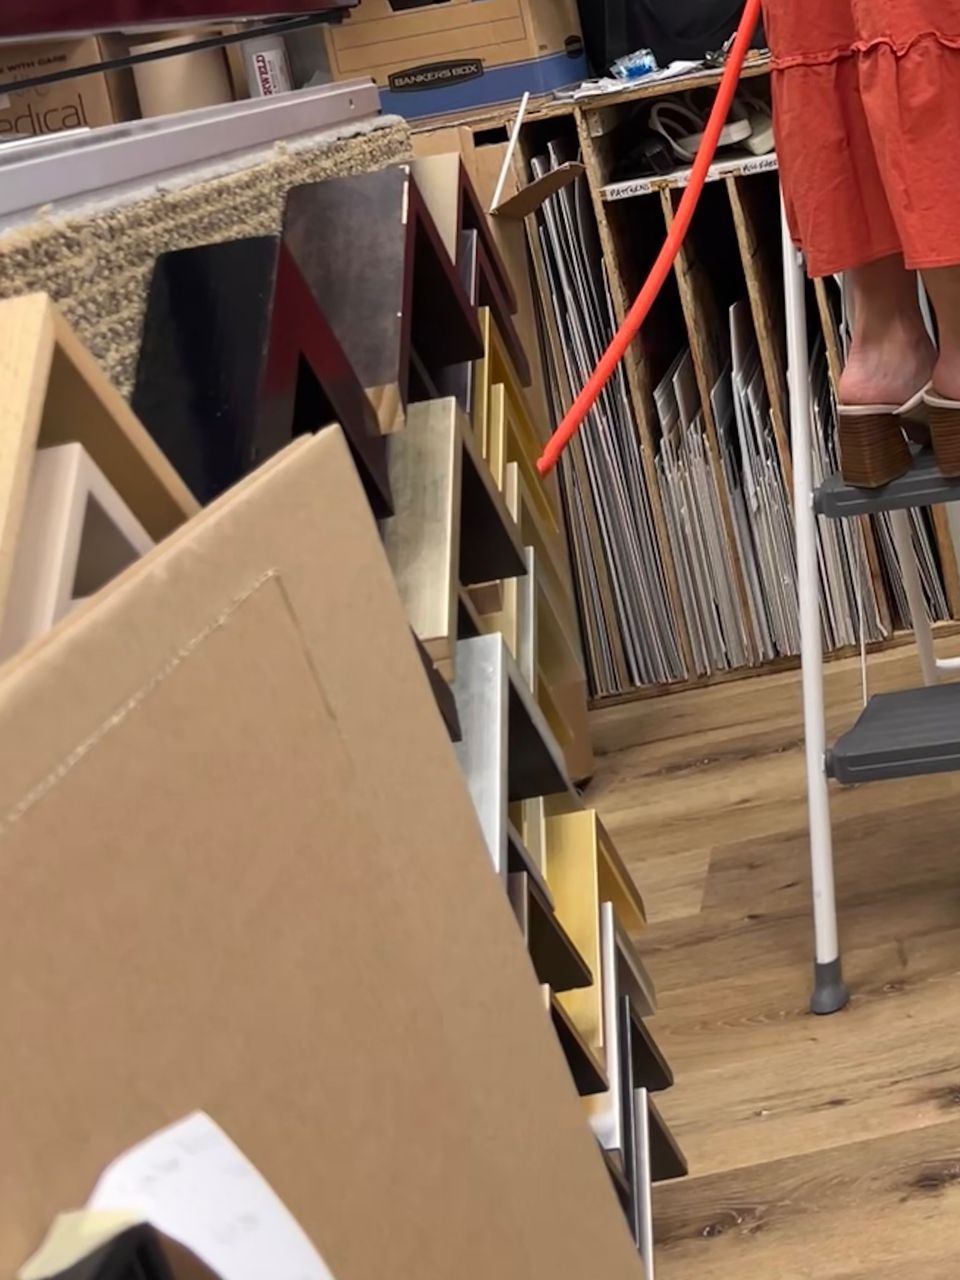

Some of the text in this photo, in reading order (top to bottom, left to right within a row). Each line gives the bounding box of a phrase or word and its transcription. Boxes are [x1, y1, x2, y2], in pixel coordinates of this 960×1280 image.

[394, 63, 479, 87] BANKERS BOX
[0, 92, 89, 135] edical
